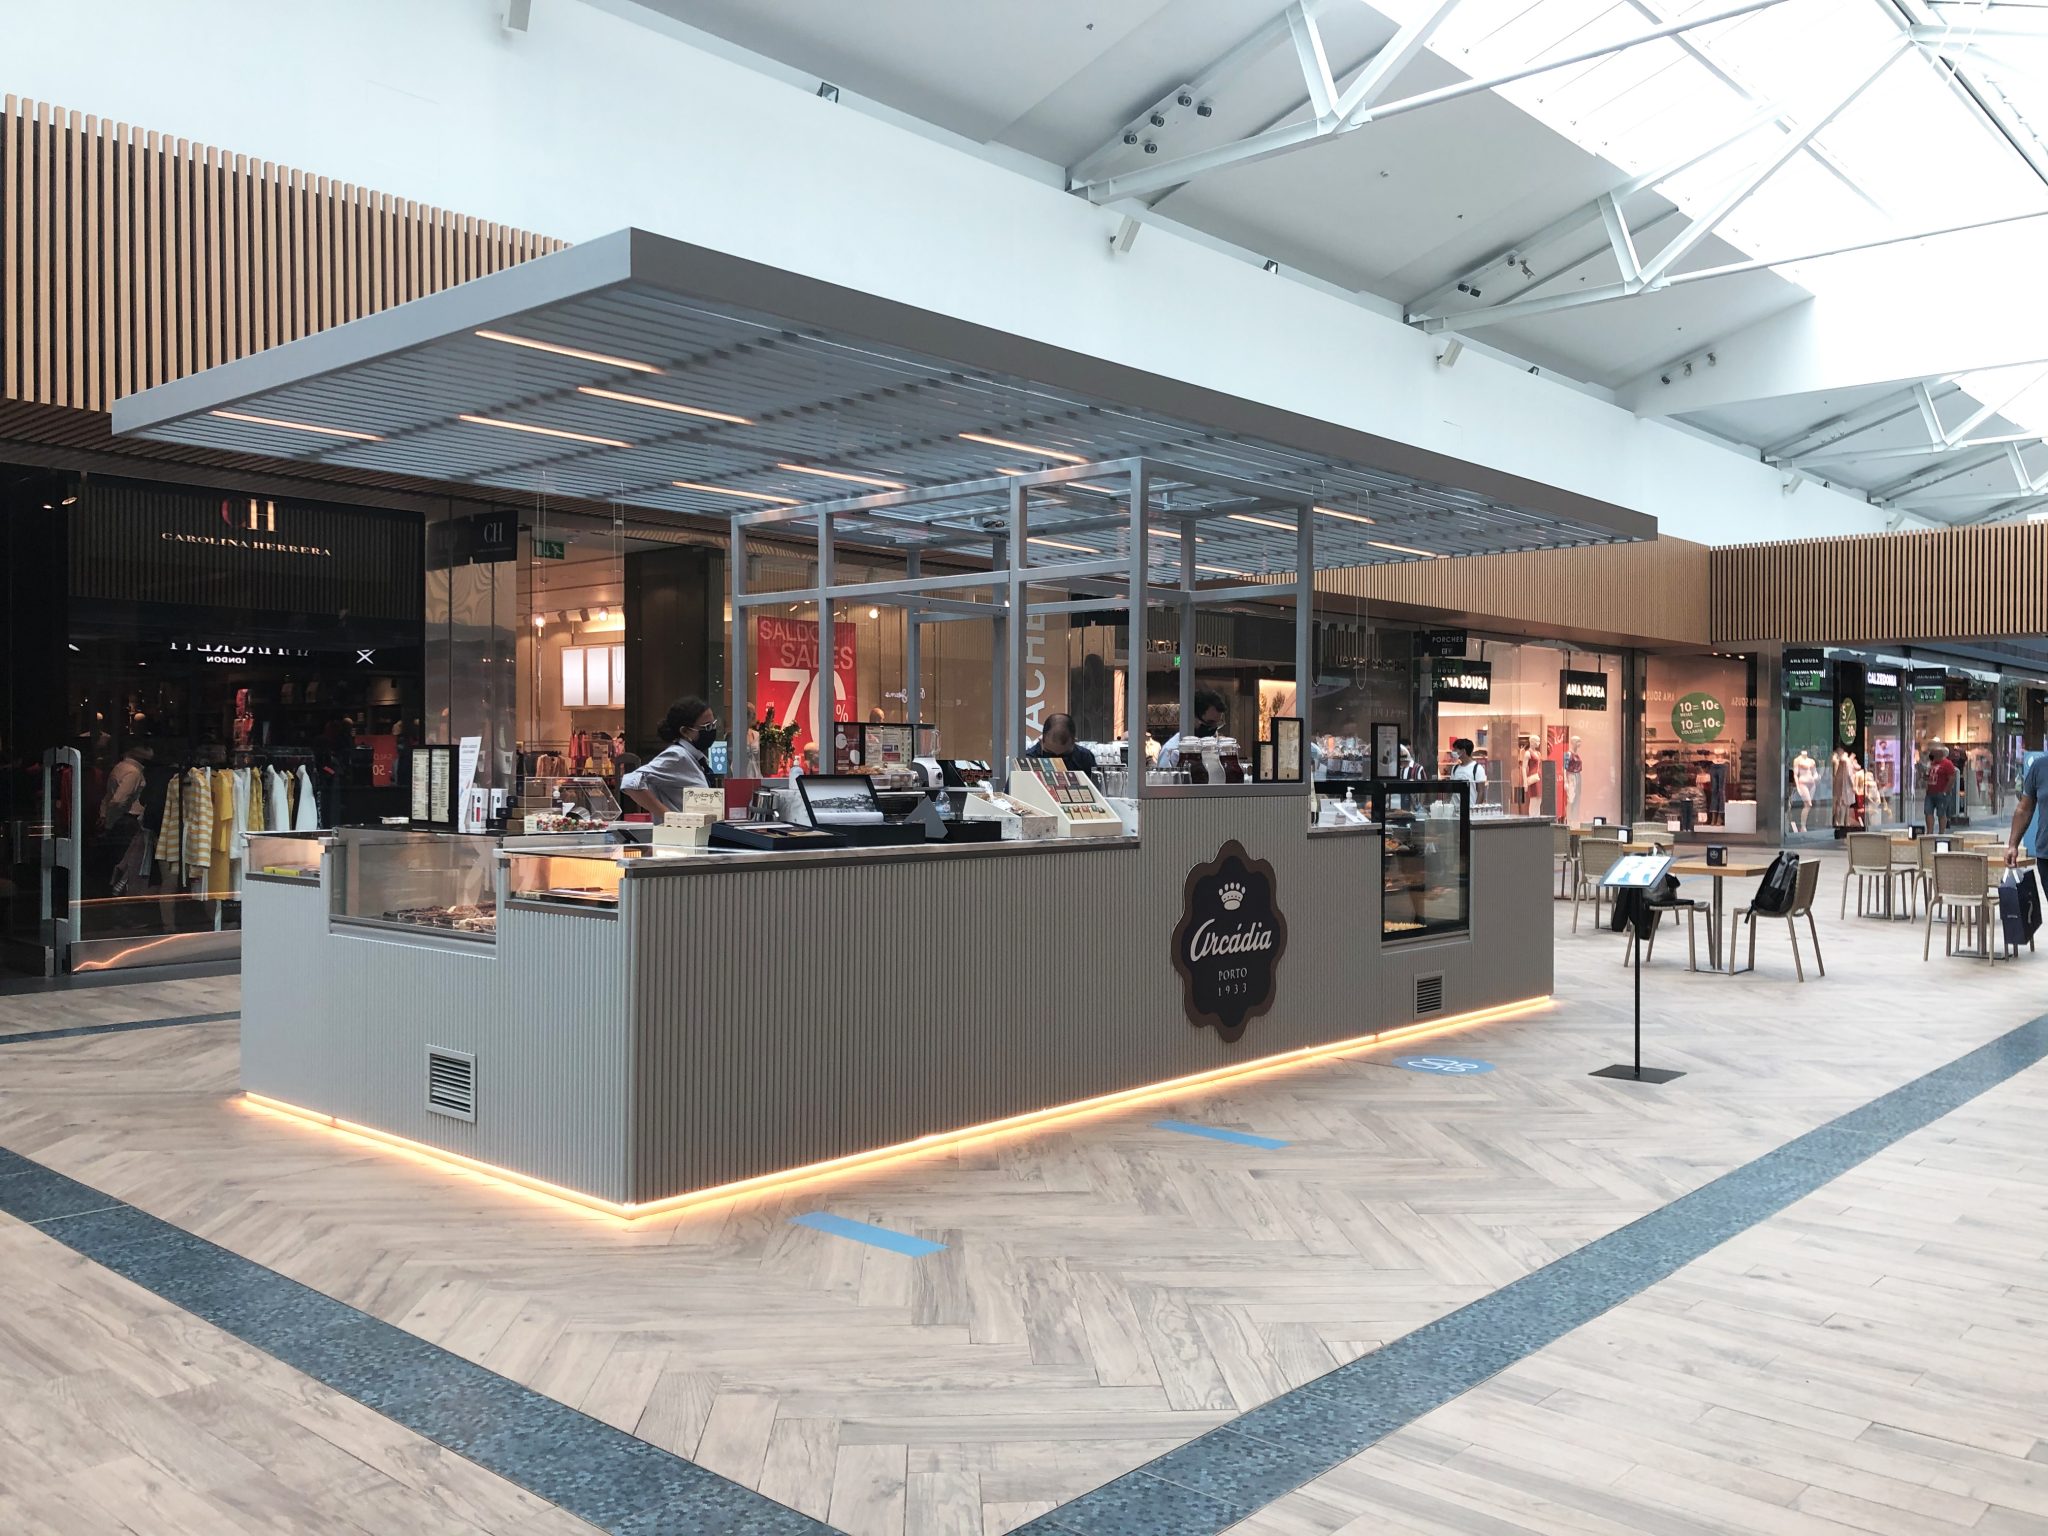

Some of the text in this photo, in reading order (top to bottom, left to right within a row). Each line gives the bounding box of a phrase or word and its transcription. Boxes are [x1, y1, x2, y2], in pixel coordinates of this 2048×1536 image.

[483, 522, 503, 543] CH
[161, 532, 332, 557] CAROLINA HERRERA
[1432, 635, 1464, 643] PORCHES
[1460, 674, 1488, 690] SOUSA
[1566, 683, 1606, 698] ANA SOUSA
[1679, 702, 1692, 713] 10
[1701, 700, 1720, 711] 10€
[1680, 719, 1694, 730] 10
[1702, 717, 1721, 728] 10€
[1190, 918, 1273, 962] Arcádia
[1218, 967, 1248, 981] PORTO
[1218, 982, 1247, 997] 1933
